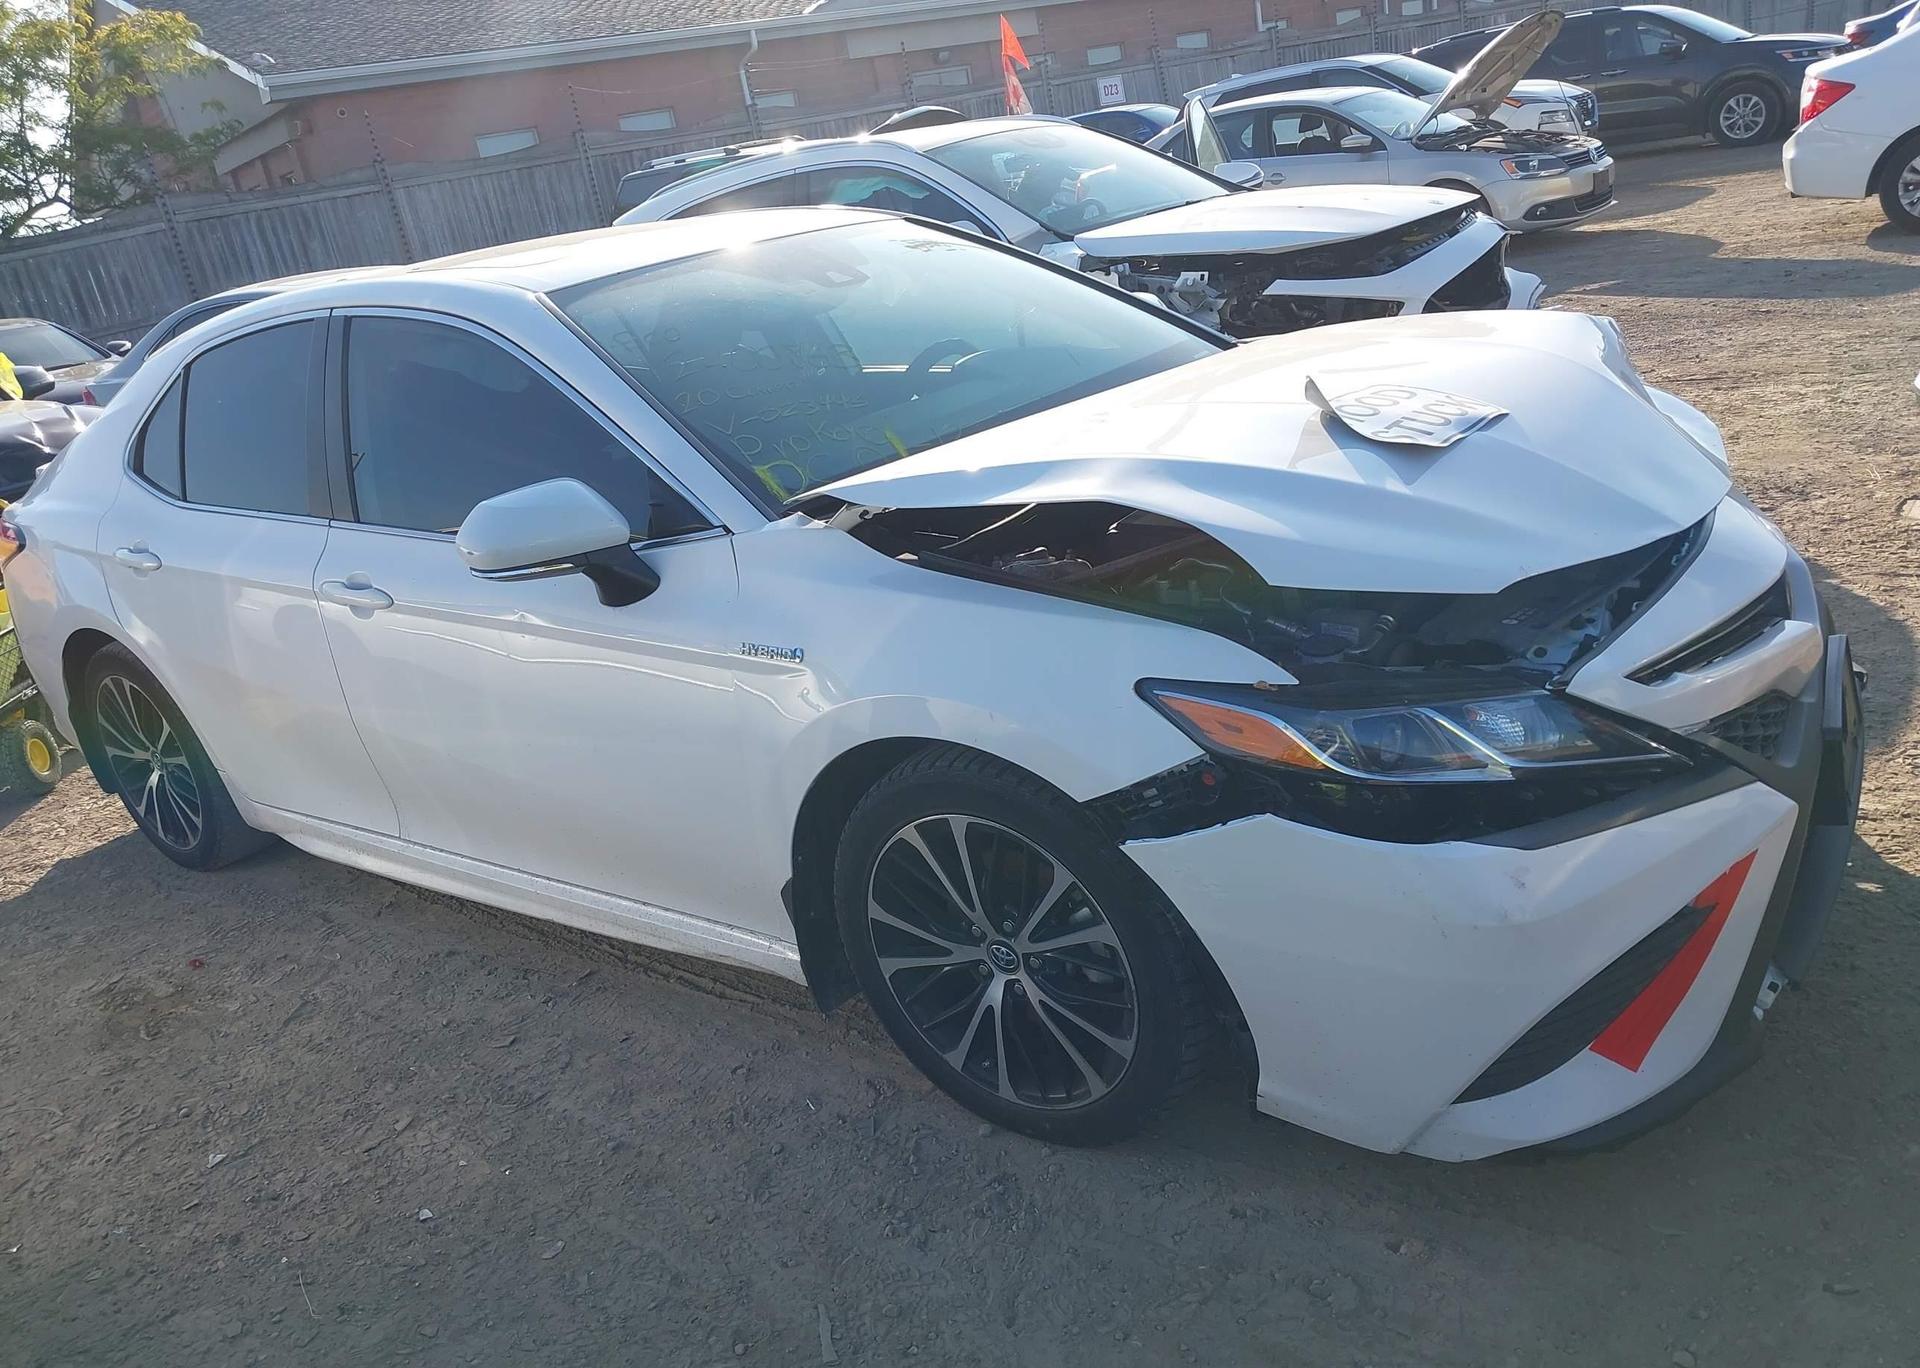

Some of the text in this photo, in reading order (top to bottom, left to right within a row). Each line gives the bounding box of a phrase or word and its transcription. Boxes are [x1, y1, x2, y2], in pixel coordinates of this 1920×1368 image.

[1103, 83, 1120, 97] DZ3
[1334, 389, 1418, 423] OOD
[739, 642, 794, 661] HYBRID
